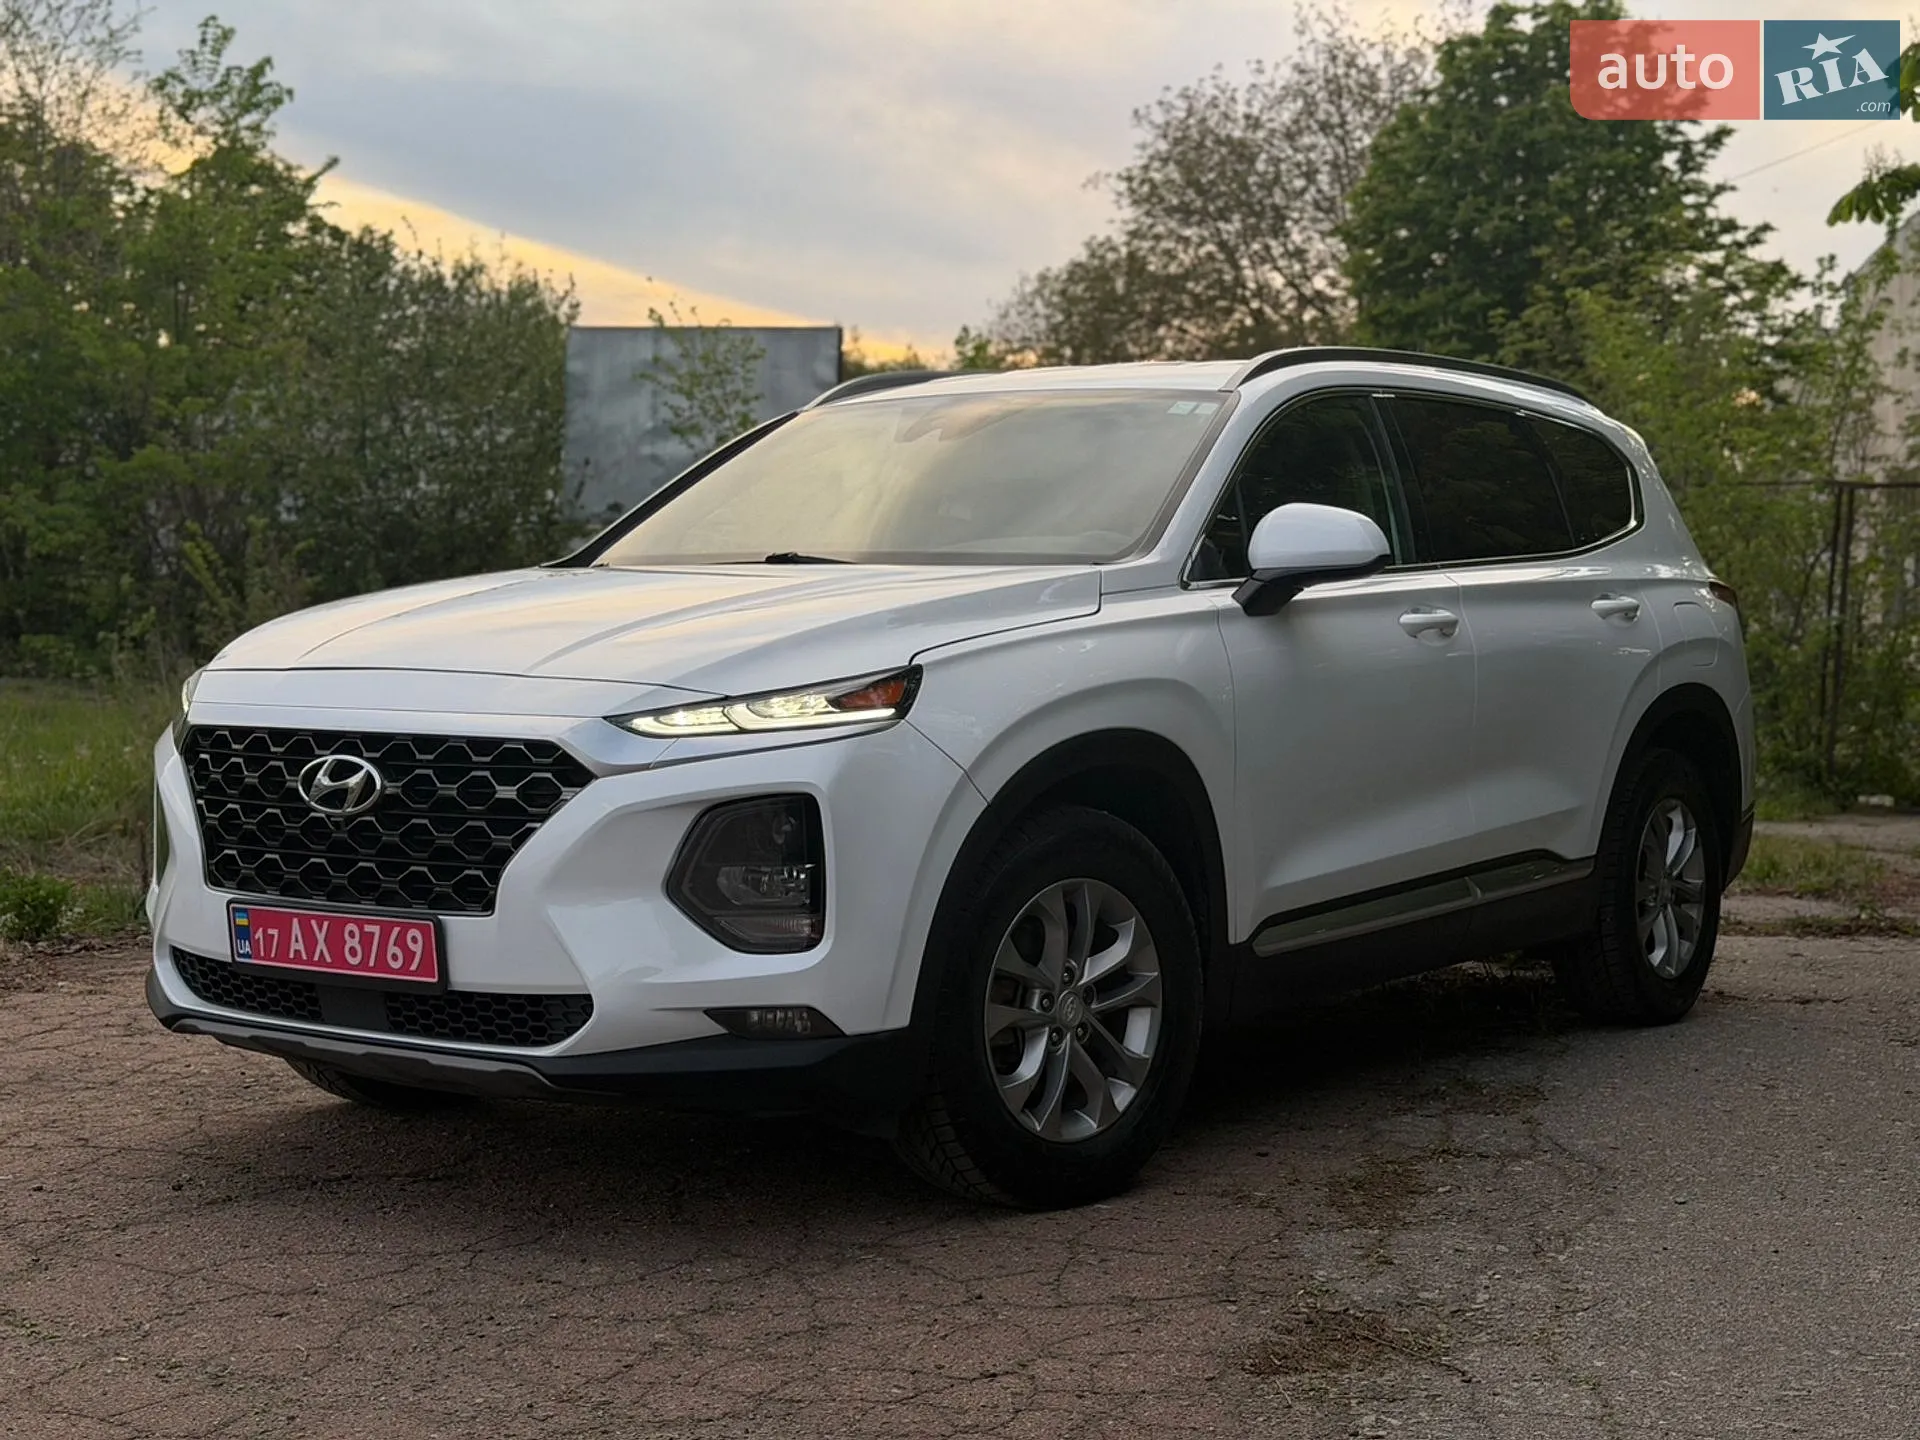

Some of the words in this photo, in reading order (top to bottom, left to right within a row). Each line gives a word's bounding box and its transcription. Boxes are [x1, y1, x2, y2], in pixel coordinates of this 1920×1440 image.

[237, 939, 252, 954] UA
[255, 928, 280, 958] 17
[289, 918, 332, 963] AX
[344, 923, 424, 971] 8769
